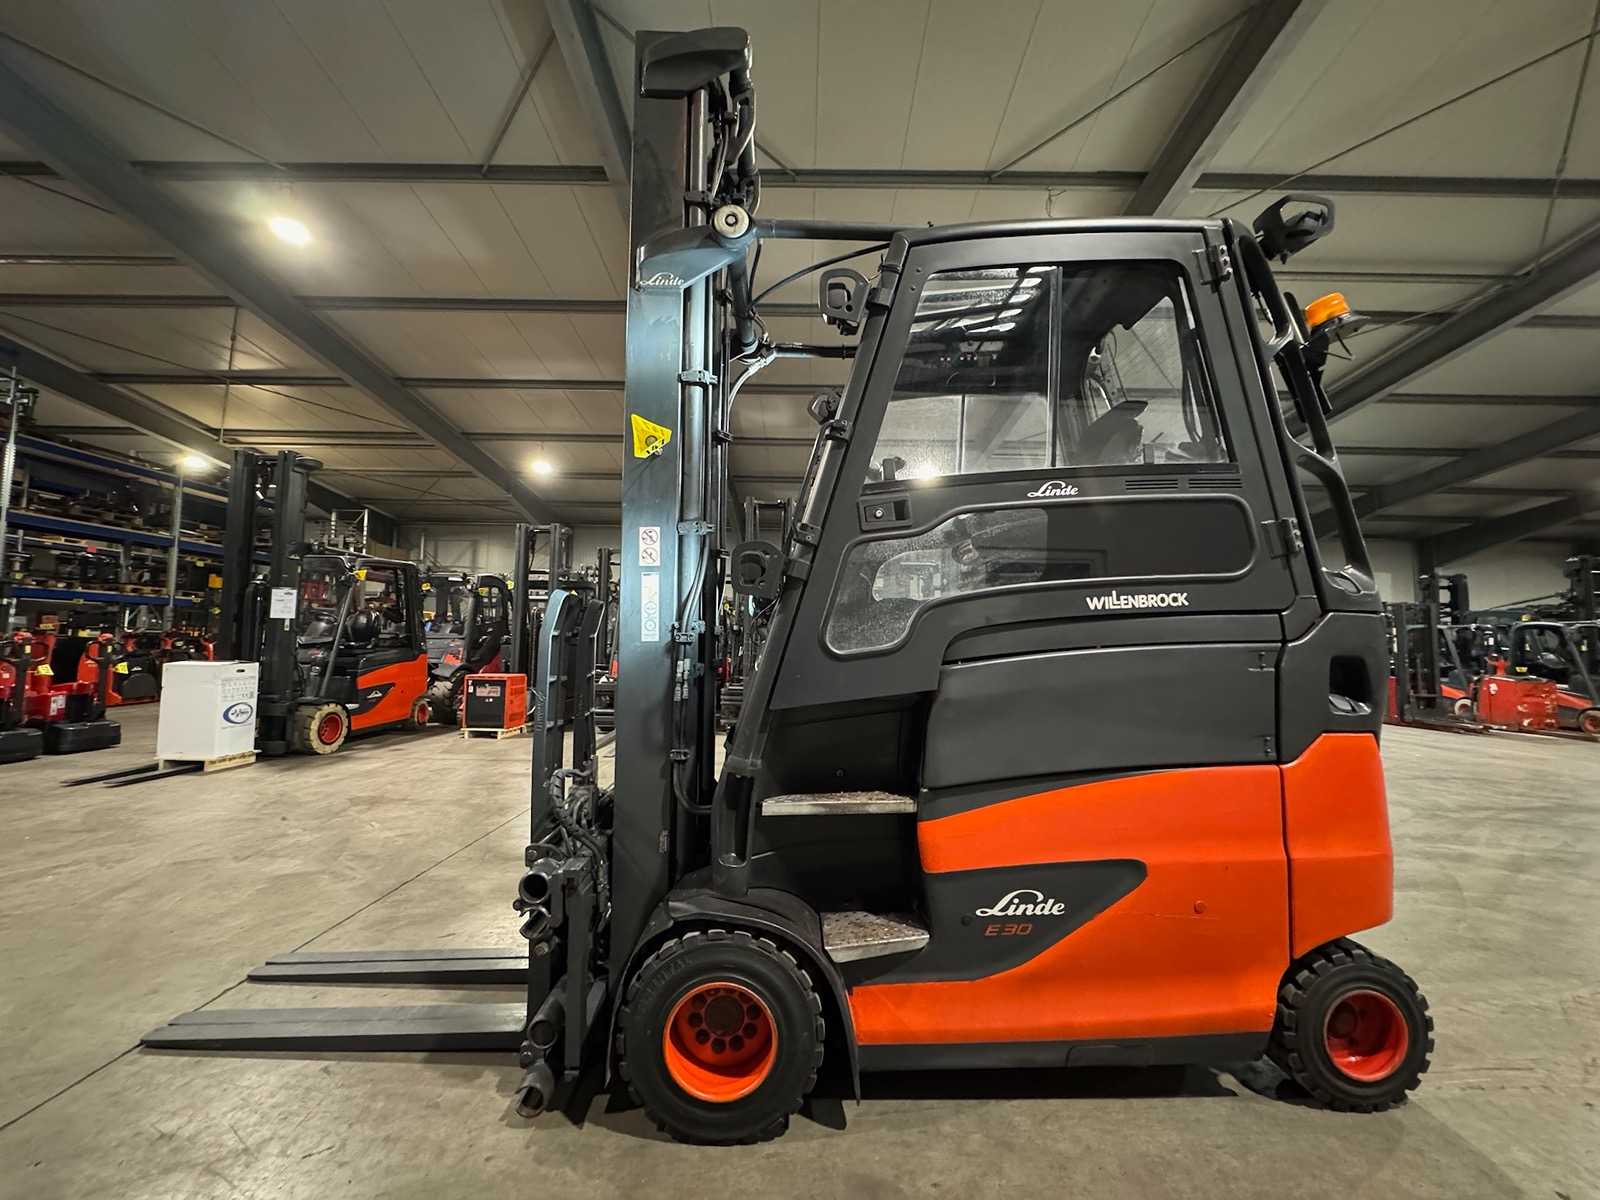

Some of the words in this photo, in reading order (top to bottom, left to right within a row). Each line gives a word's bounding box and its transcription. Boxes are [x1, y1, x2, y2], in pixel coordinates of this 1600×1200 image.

[640, 272, 684, 286] Linde
[1027, 480, 1079, 498] Linde
[1086, 590, 1189, 610] WILLENBROCK
[976, 889, 1065, 917] Linde
